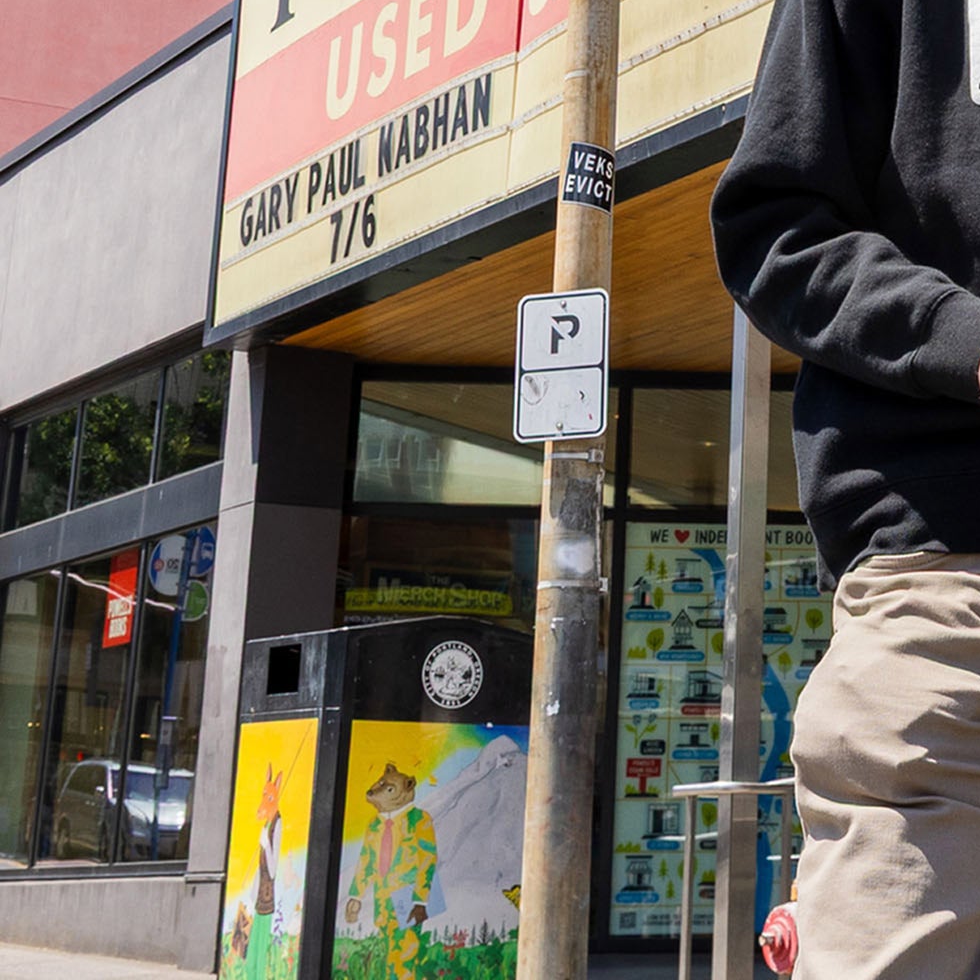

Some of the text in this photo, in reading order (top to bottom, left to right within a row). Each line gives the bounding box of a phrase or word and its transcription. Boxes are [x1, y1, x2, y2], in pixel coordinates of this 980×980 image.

[240, 172, 299, 247] GARY
[307, 138, 365, 214] PAUL
[565, 174, 612, 203] EVICT
[330, 194, 377, 263] 7/6
[650, 529, 669, 544] WE
